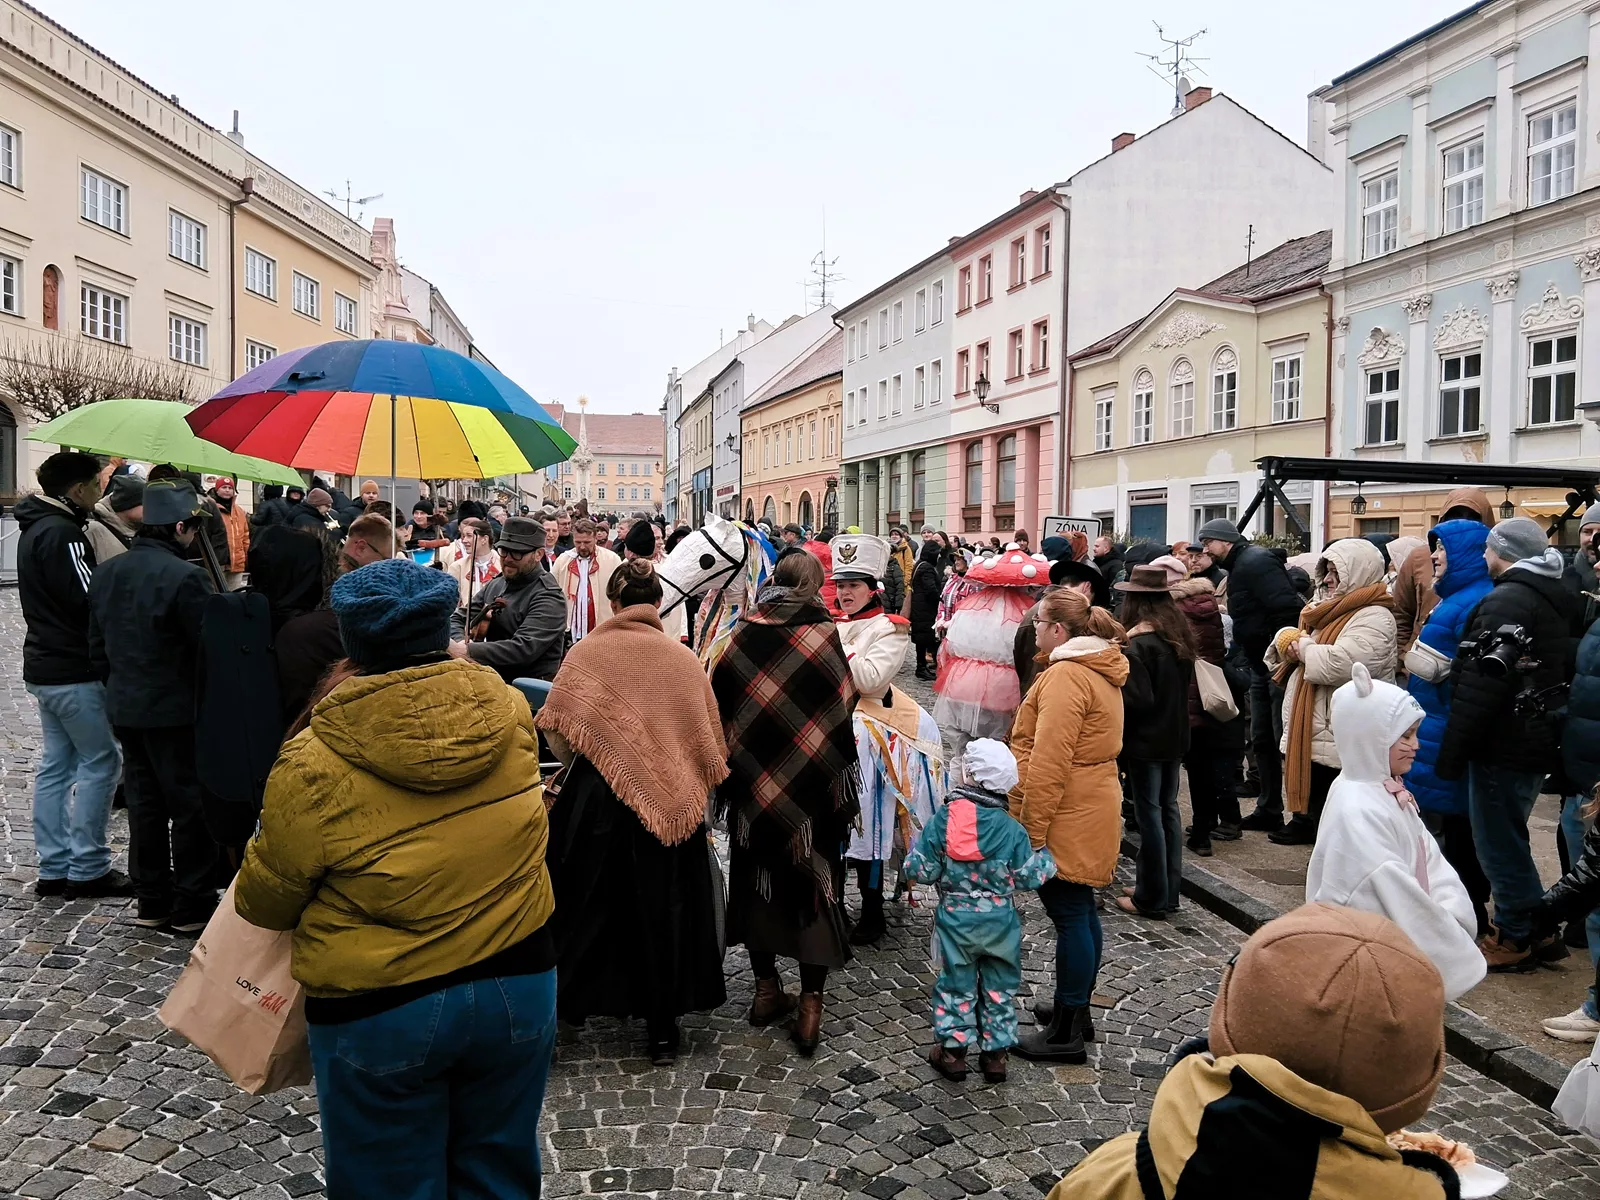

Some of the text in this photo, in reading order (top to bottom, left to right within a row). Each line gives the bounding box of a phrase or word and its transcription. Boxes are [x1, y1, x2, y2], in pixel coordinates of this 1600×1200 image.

[1055, 520, 1088, 534] ZÓNA
[236, 976, 288, 1015] LOVE H&M
